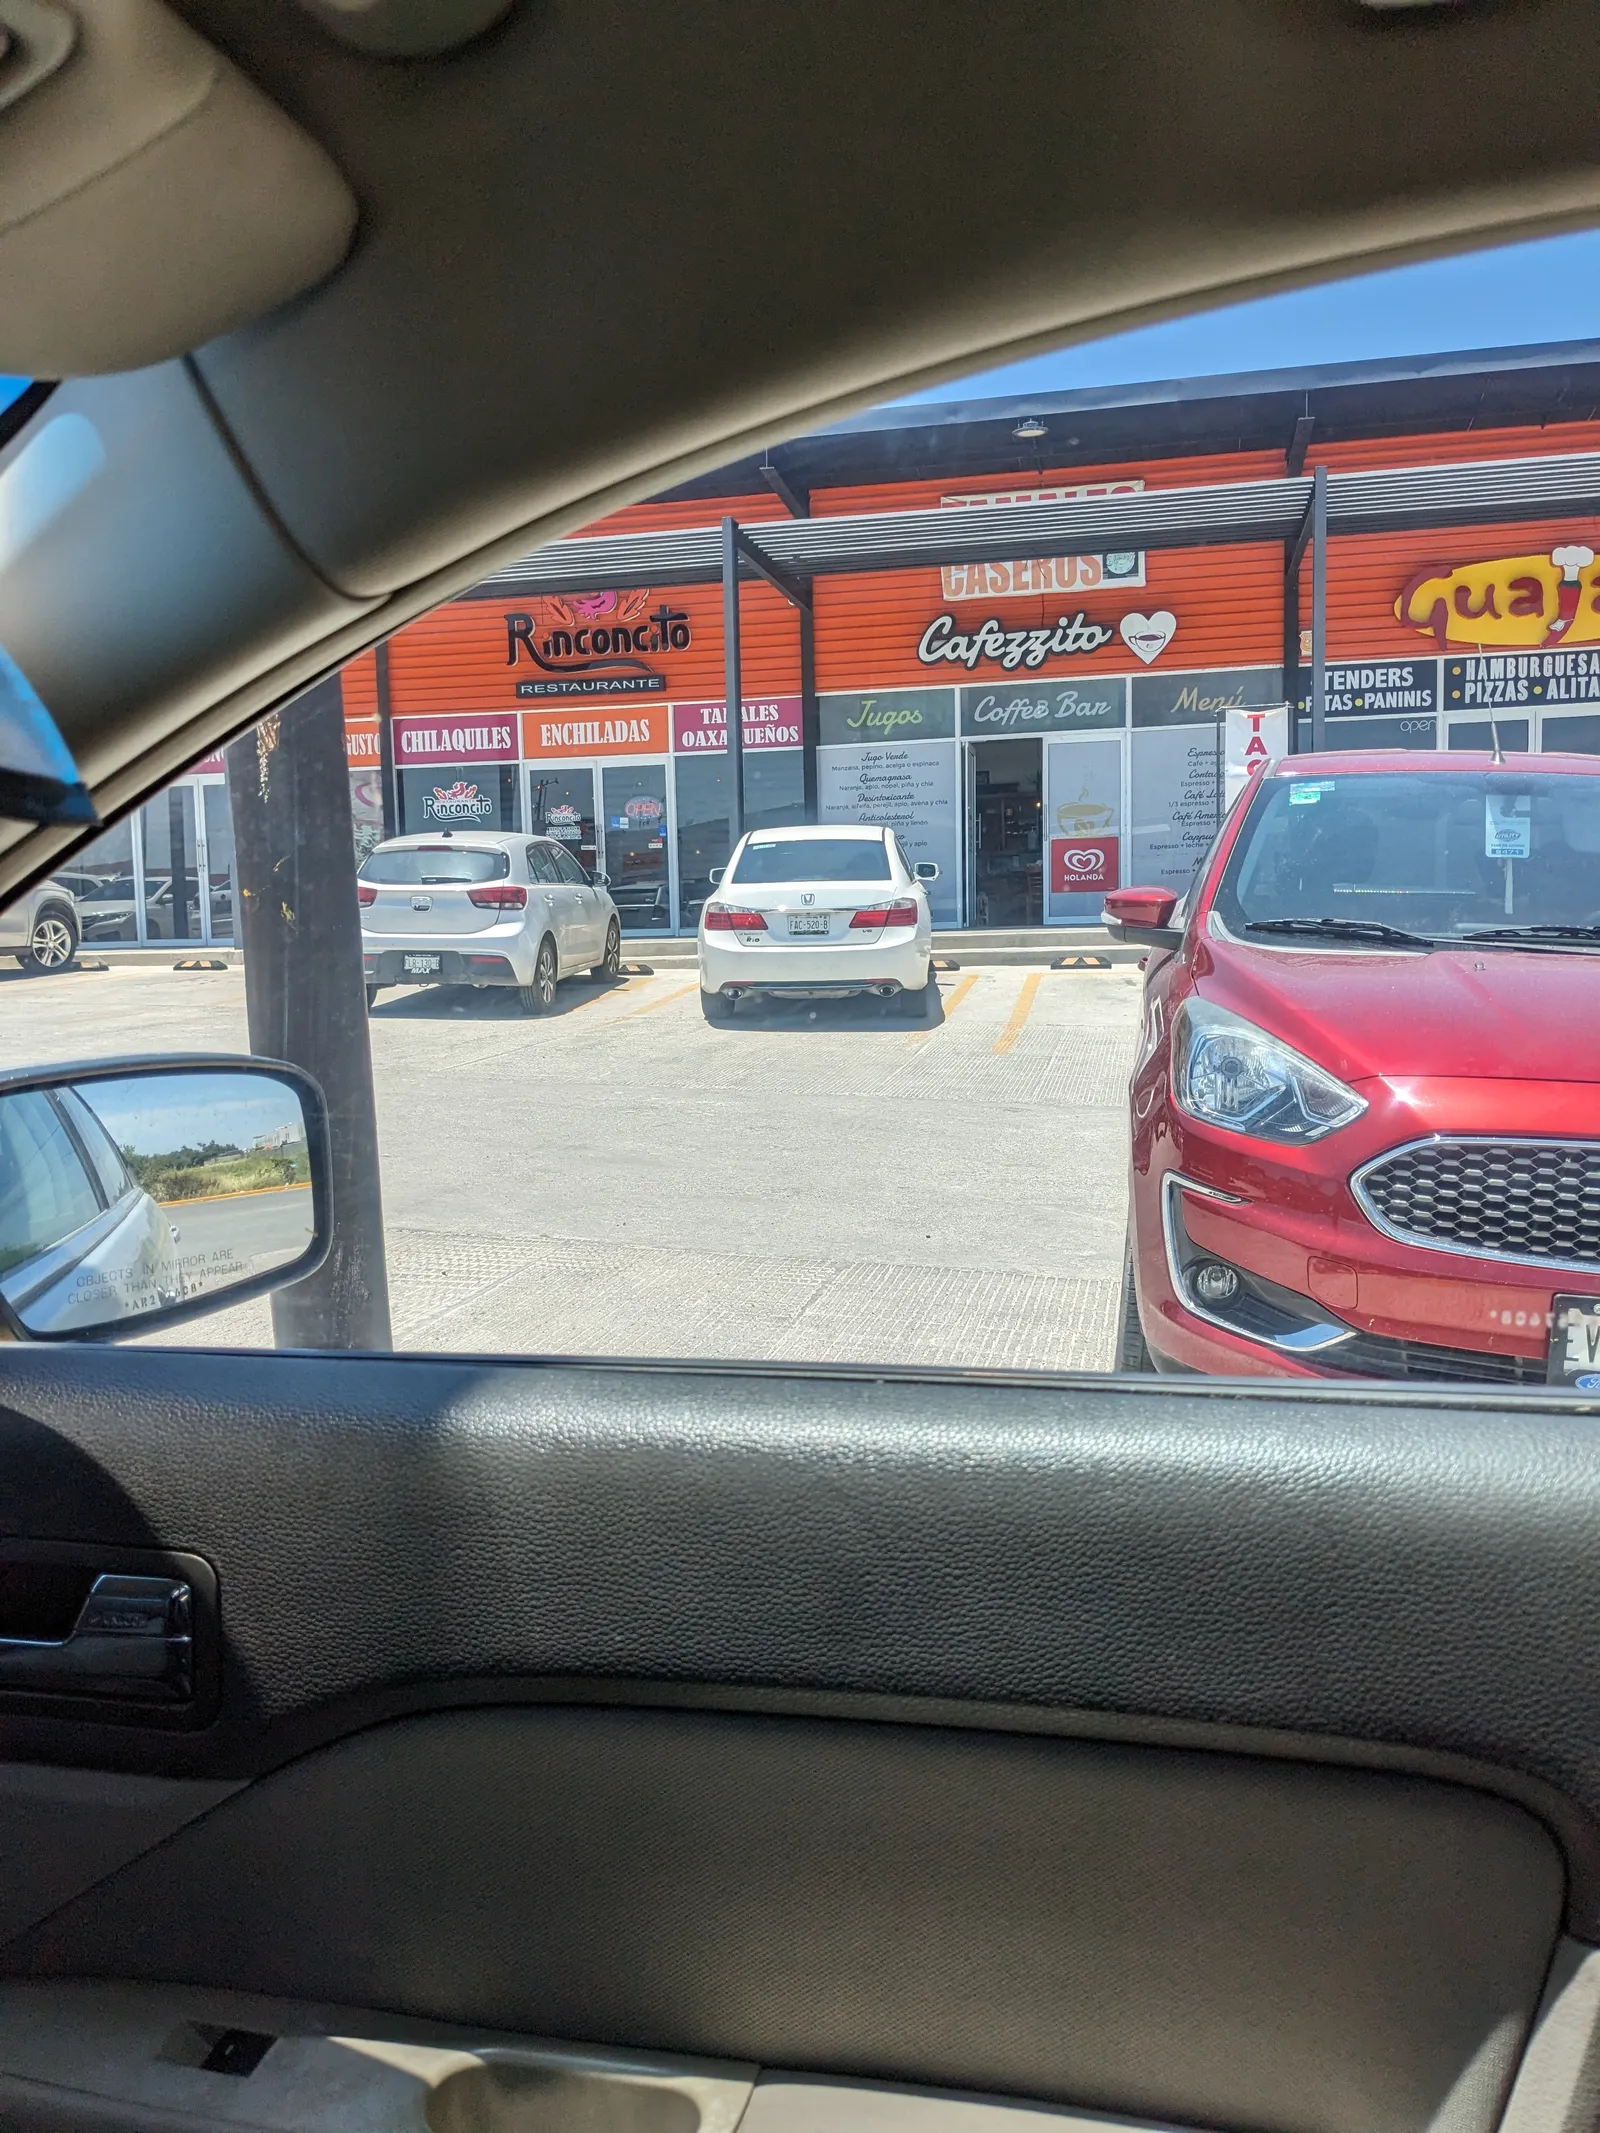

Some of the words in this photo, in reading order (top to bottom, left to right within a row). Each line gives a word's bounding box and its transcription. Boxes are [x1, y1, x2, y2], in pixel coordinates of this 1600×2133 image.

[504, 604, 692, 673] Rinconcito
[918, 611, 1113, 670] Cafezzito
[520, 677, 661, 695] RESTAURANTE
[1464, 679, 1529, 704] PIZZAS
[974, 695, 1050, 726] Coffee
[1053, 690, 1112, 719] Bar
[1170, 685, 1246, 713] Menú
[1305, 693, 1353, 712] PTAS
[1364, 690, 1432, 709] PANINIS
[700, 704, 779, 725] TAALES
[847, 699, 923, 735] Jugos
[401, 726, 512, 754] CHILAQUILES
[540, 718, 651, 747] ENCHILADAS
[681, 724, 799, 747] OAXAUEÑOS
[861, 751, 883, 765] Jugo
[885, 750, 909, 760] Verde
[1187, 747, 1225, 759] Espreso
[912, 760, 940, 768] espinaca
[859, 773, 912, 784] Quemagrasa
[1189, 769, 1225, 779] Cortao
[1180, 780, 1210, 788] Espresso
[857, 791, 915, 803] Desintoxicante
[1180, 800, 1210, 808] espresso
[1184, 789, 1204, 801] Café
[423, 794, 493, 823] Rinconcito
[625, 801, 662, 817] OPEN
[858, 811, 915, 822] Anticolesterol
[1172, 811, 1193, 822] Café
[545, 811, 582, 826] Rinconcito
[1064, 873, 1104, 882] HOLANDA
[76, 1267, 134, 1288] OBJECTS
[142, 1262, 155, 1275] IN
[161, 1253, 207, 1272] MIRROR
[212, 1248, 234, 1263] ARE
[67, 1286, 118, 1305] CLOSER
[124, 1278, 157, 1294] THAN
[164, 1271, 193, 1287] THEY
[199, 1261, 244, 1279] APPEAR
